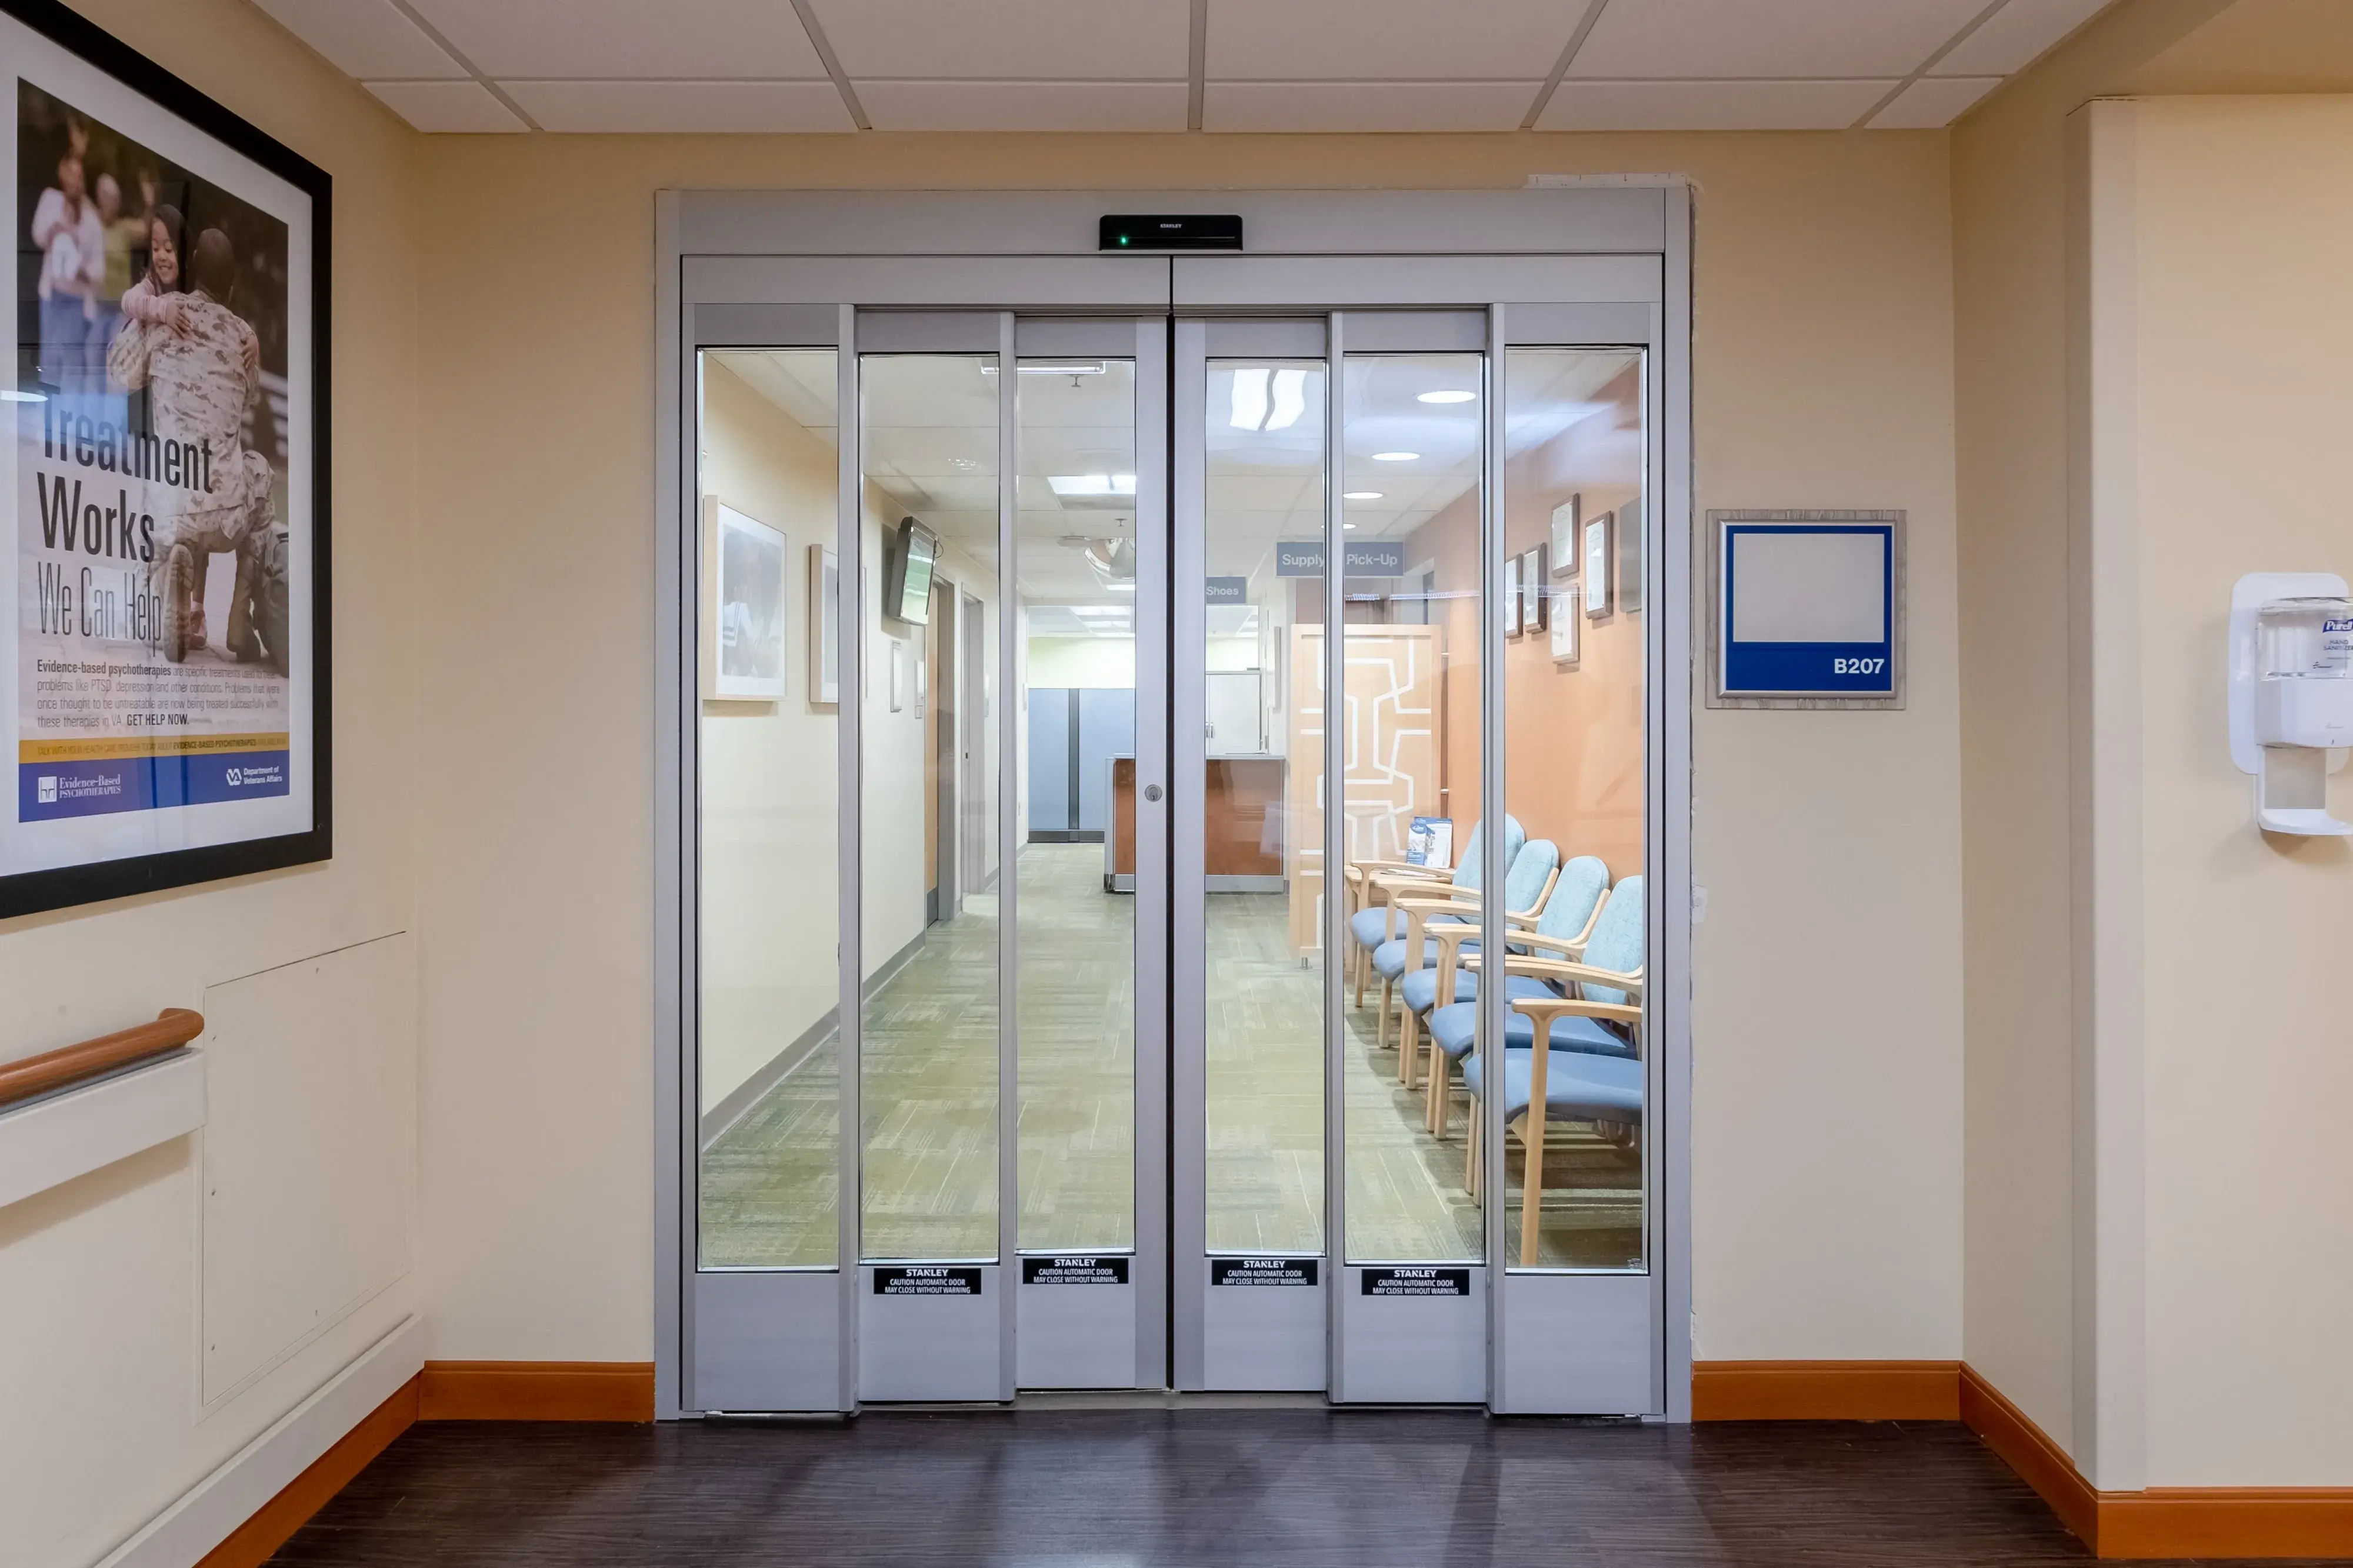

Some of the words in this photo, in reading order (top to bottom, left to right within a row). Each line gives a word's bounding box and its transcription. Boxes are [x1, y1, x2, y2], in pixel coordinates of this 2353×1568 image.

[39, 388, 213, 493] Treatment
[37, 472, 155, 563] Works
[1282, 554, 1323, 568] Supply
[1347, 554, 1398, 567] Pick-Up
[1207, 586, 1239, 596] Shoes
[38, 561, 72, 636] We
[81, 567, 115, 639] Can
[124, 572, 161, 657] Help
[38, 659, 106, 674] Evidence-based
[109, 663, 171, 679] psychotherapies
[174, 668, 183, 676] are
[186, 666, 207, 678] specific
[1834, 658, 1885, 674] B207
[38, 679, 73, 693] problems
[76, 679, 88, 691] like
[116, 680, 154, 695] depression
[156, 682, 168, 693] and
[171, 682, 188, 693] other
[225, 682, 251, 693] Problems
[254, 682, 264, 693] that
[266, 685, 280, 694] were
[38, 698, 57, 709] once
[60, 696, 90, 712] thought
[93, 698, 101, 709] to
[103, 698, 113, 709] be
[115, 697, 155, 709] untreatable
[158, 700, 168, 709] are
[171, 700, 185, 709] now
[187, 698, 205, 711] being
[206, 699, 228, 709] treated
[230, 698, 264, 711] successfully
[266, 699, 279, 709] with
[38, 715, 60, 728] these
[64, 713, 99, 731] therapies
[102, 715, 109, 726] in
[126, 713, 142, 726] GET
[145, 713, 165, 726] HELP
[168, 713, 189, 725] NOW.
[174, 740, 214, 749] EVIDENCE-BASED
[215, 738, 256, 748] PSYCHOTHERAPIES
[244, 766, 272, 776] Department
[59, 774, 121, 789] Evidence-Based
[244, 776, 265, 785] Veterans
[266, 775, 282, 783] Affairs
[59, 785, 121, 799] PSYCHOTHERAPIES
